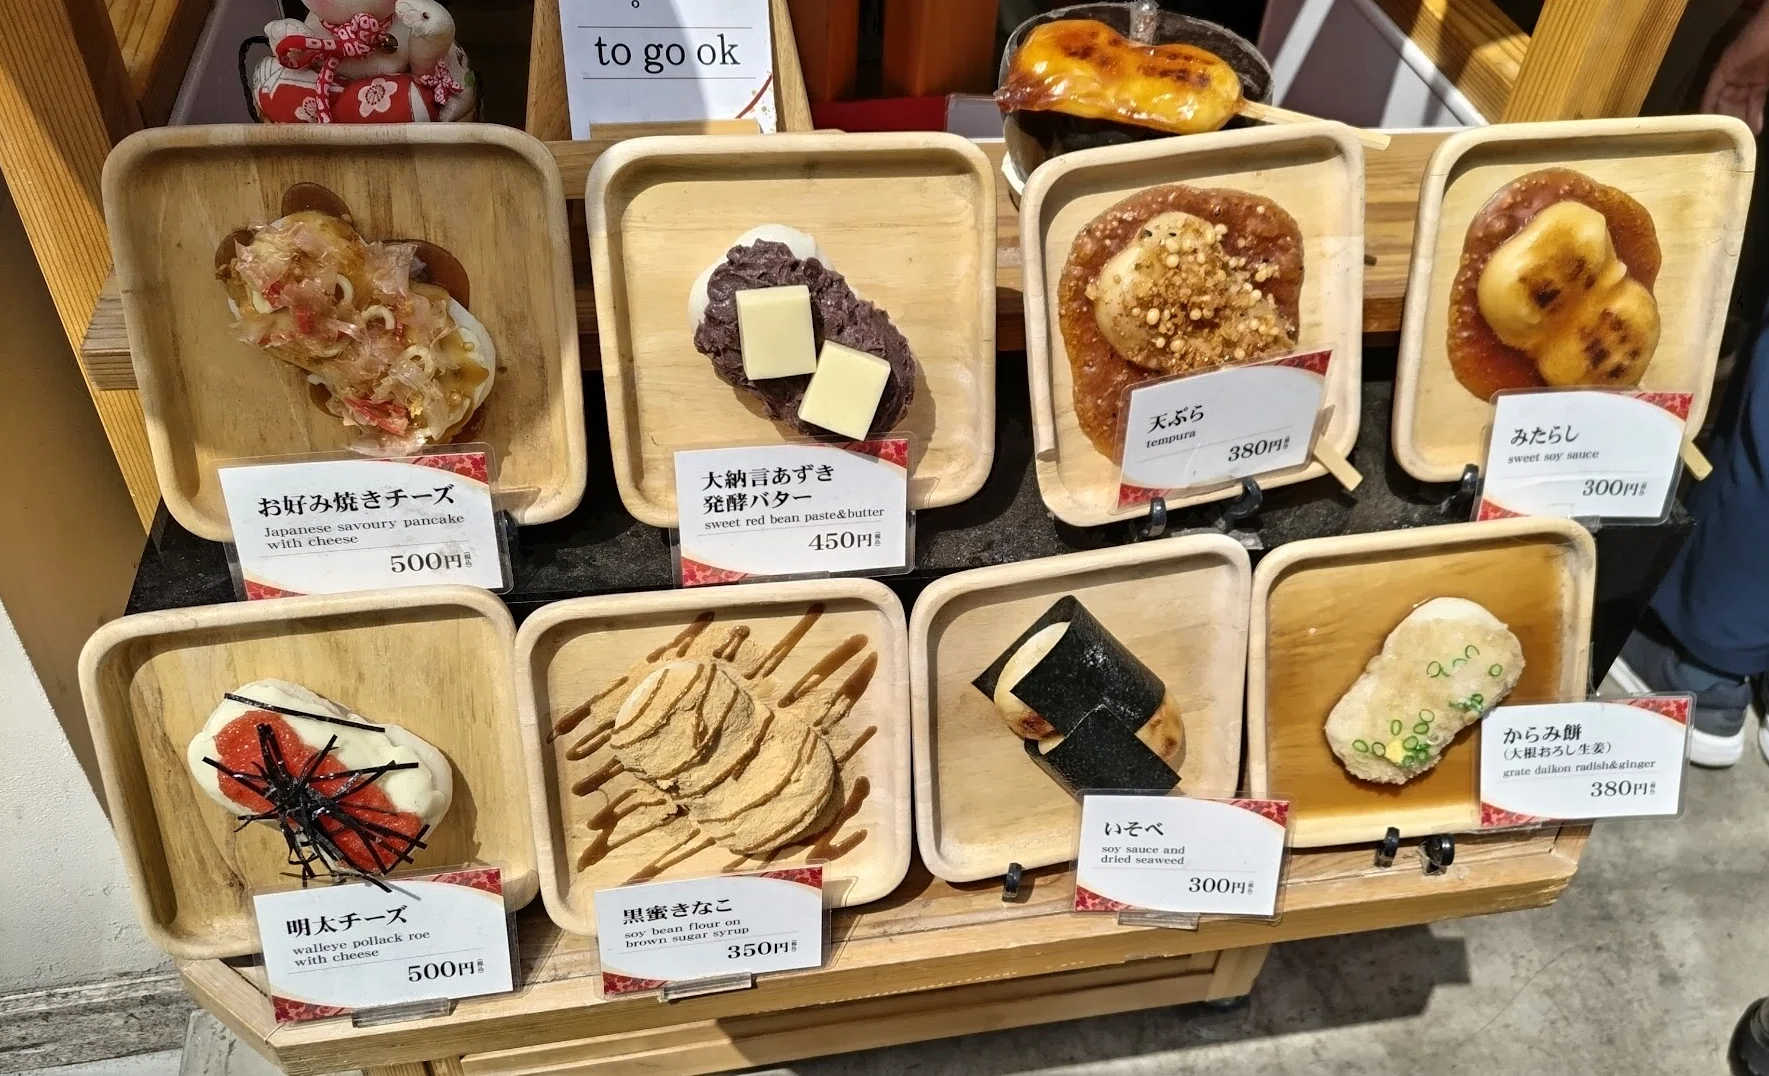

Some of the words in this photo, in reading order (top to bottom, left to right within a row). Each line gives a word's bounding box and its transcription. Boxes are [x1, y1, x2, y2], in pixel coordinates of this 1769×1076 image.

[594, 36, 632, 66] to
[644, 43, 685, 74] go
[697, 33, 741, 65] ok
[1148, 405, 1204, 434] 天ぷら
[1146, 430, 1196, 448] tempura
[1510, 425, 1579, 446] みたらし
[1227, 438, 1283, 462] 380円
[1508, 452, 1540, 464] sweet
[1544, 452, 1563, 462] soy
[1567, 450, 1599, 460] sauce
[701, 464, 835, 492] 大納言あずき
[1583, 479, 1638, 497] 300円
[257, 484, 455, 518] お好み焼きチーズ
[703, 490, 812, 515] 発酵バター
[264, 524, 332, 538] Japanese
[337, 519, 397, 533] savoury
[404, 513, 465, 528] pancake
[705, 518, 741, 530] sweet
[745, 515, 765, 526] red
[770, 514, 800, 524] bean
[804, 508, 884, 523] paste&butter
[268, 539, 303, 550] with
[308, 534, 358, 547] cheese
[808, 531, 872, 551] 450円
[390, 552, 463, 573] 500円
[1503, 723, 1582, 745] からみ餅
[1503, 768, 1530, 778] grate
[1535, 765, 1571, 774] daikon
[1575, 760, 1656, 771] radish&ginger
[1590, 780, 1648, 797] 380円
[1104, 821, 1164, 837] いそべ
[1101, 854, 1131, 864] dried
[1135, 856, 1185, 865] seaweed
[1102, 845, 1122, 854] soy
[1126, 845, 1159, 854] sauce
[1163, 845, 1185, 855] and
[1189, 877, 1246, 895] 300円
[286, 904, 409, 938] 明太チーズ
[622, 898, 733, 925] 黒蜜きなこ
[624, 929, 646, 939] soy
[652, 925, 683, 935] bean
[689, 920, 720, 931] flour
[725, 918, 741, 927] on
[626, 936, 667, 948] brown
[672, 932, 709, 944] sugar
[713, 927, 749, 939] syrup
[292, 940, 348, 956] walleye
[353, 933, 404, 950] pollack
[409, 930, 430, 941] roe
[728, 941, 789, 960] 350円
[294, 955, 327, 967] with
[332, 948, 379, 962] cheese
[408, 960, 475, 983] 500円
